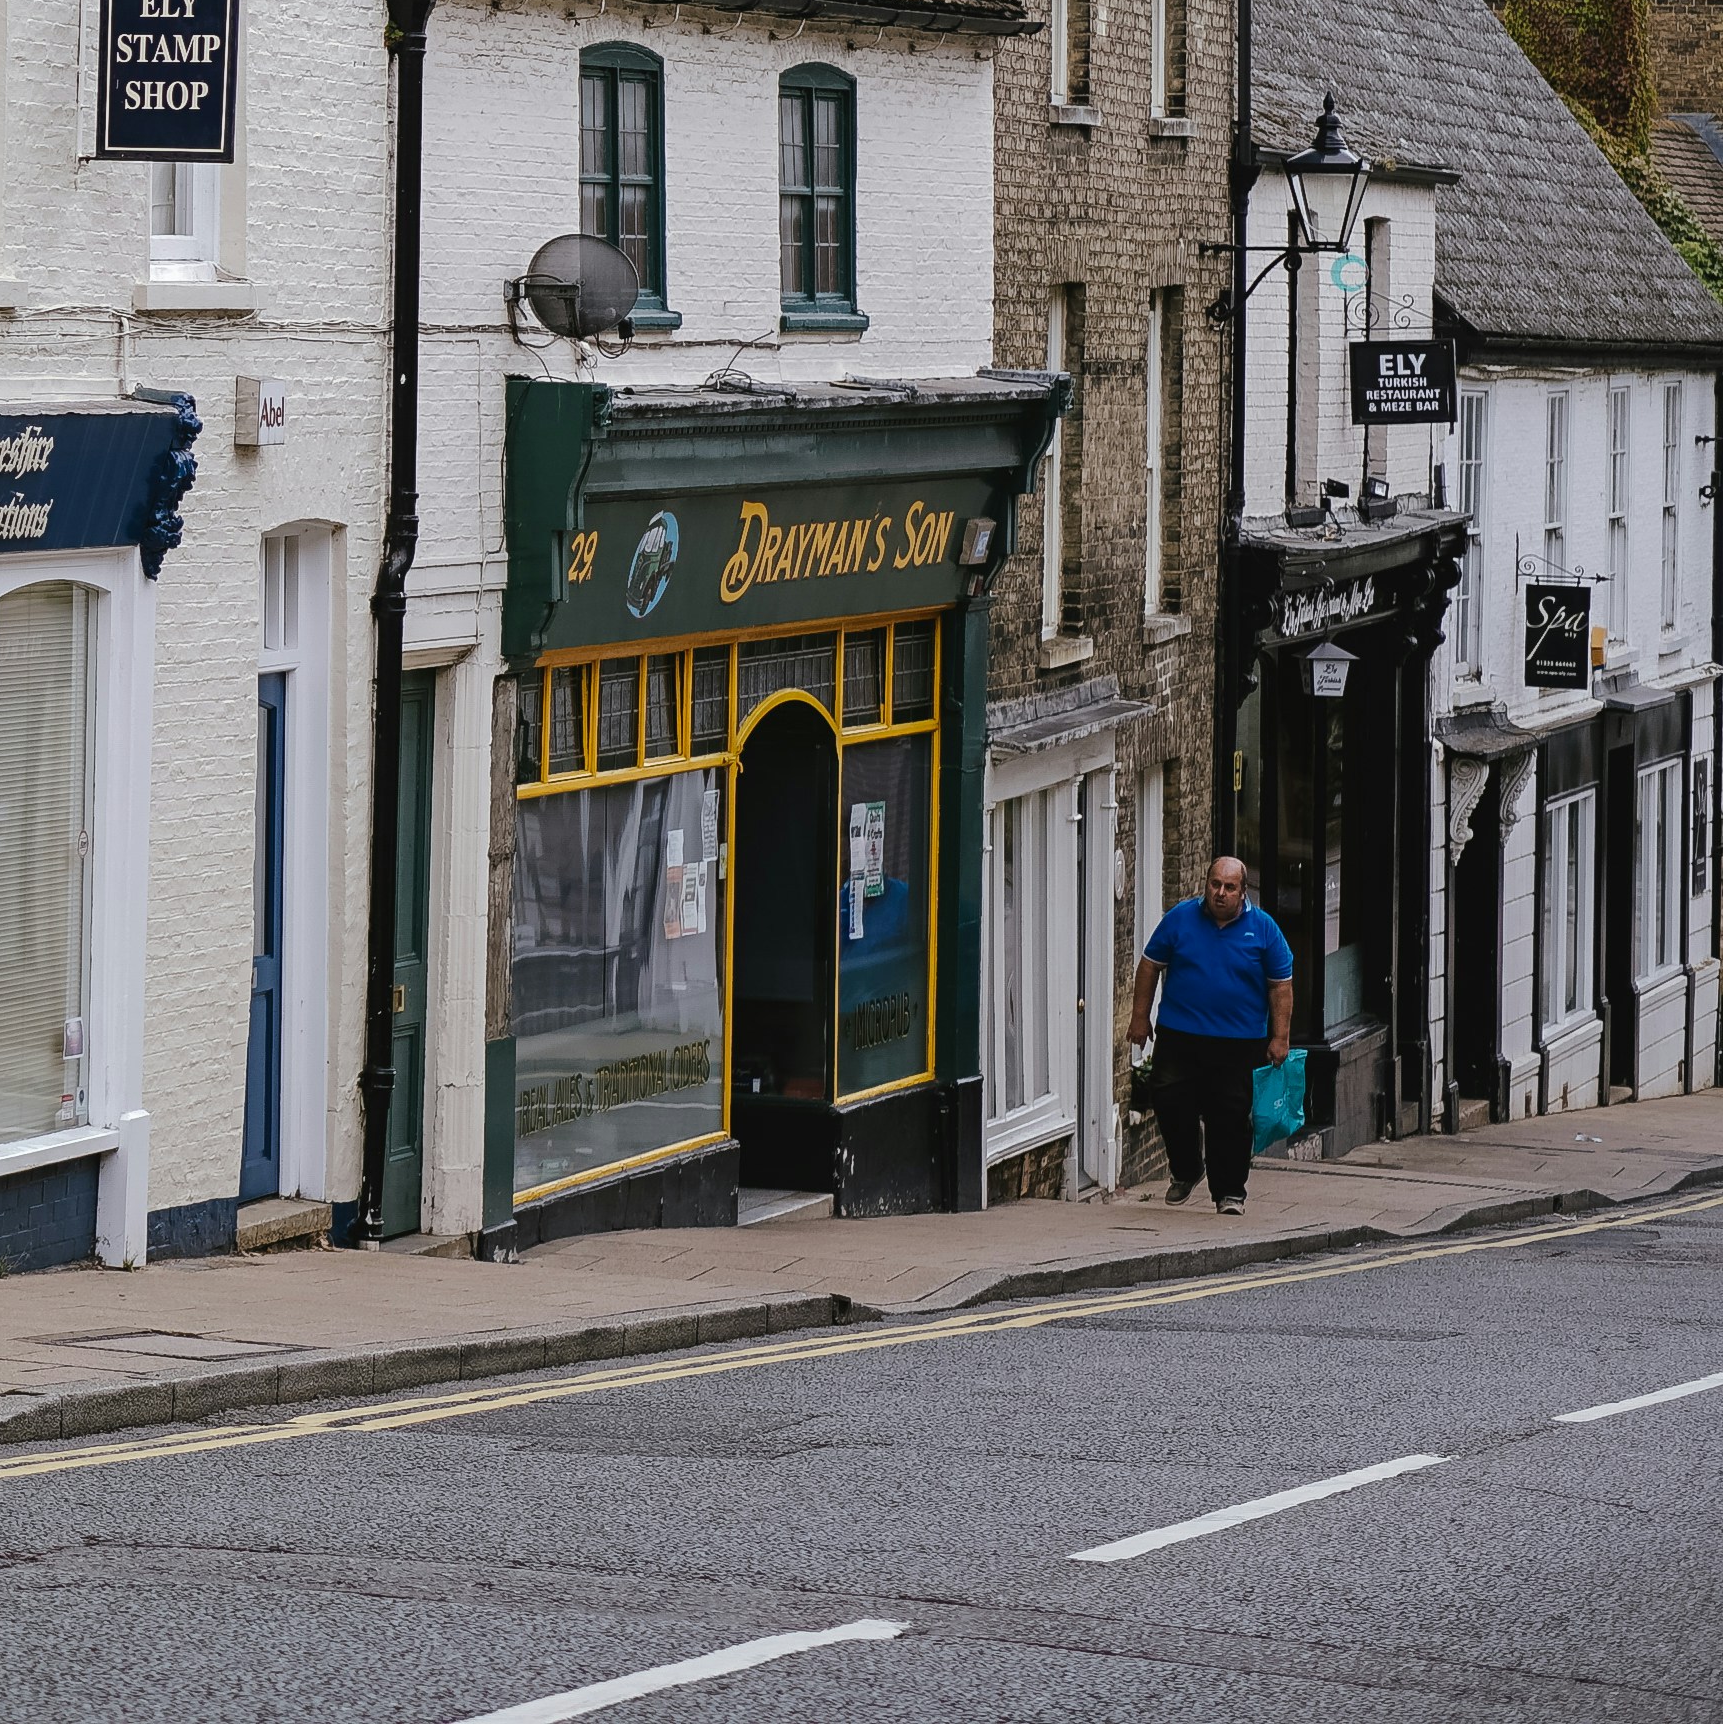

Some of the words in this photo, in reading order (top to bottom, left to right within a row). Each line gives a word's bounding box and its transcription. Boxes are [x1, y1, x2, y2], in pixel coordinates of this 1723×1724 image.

[116, 34, 221, 63] STAMP
[125, 81, 209, 110] SHOP
[1379, 354, 1427, 375] ELY
[1366, 389, 1441, 400] RESTAURANT
[1378, 377, 1427, 388] TURKISH
[260, 396, 285, 428] Abel
[1368, 402, 1377, 412] &
[1381, 402, 1412, 412] MEZE
[1417, 401, 1439, 411] BAR
[720, 500, 892, 604] DRAYMAN'S
[893, 500, 954, 569] SON
[1526, 596, 1588, 660] Spa
[855, 990, 911, 1051] MICROPUB
[520, 1083, 550, 1138] REAL
[553, 1072, 583, 1127] ALES
[595, 1049, 669, 1114] TRADITIONAL
[672, 1039, 710, 1092] CIDERS
